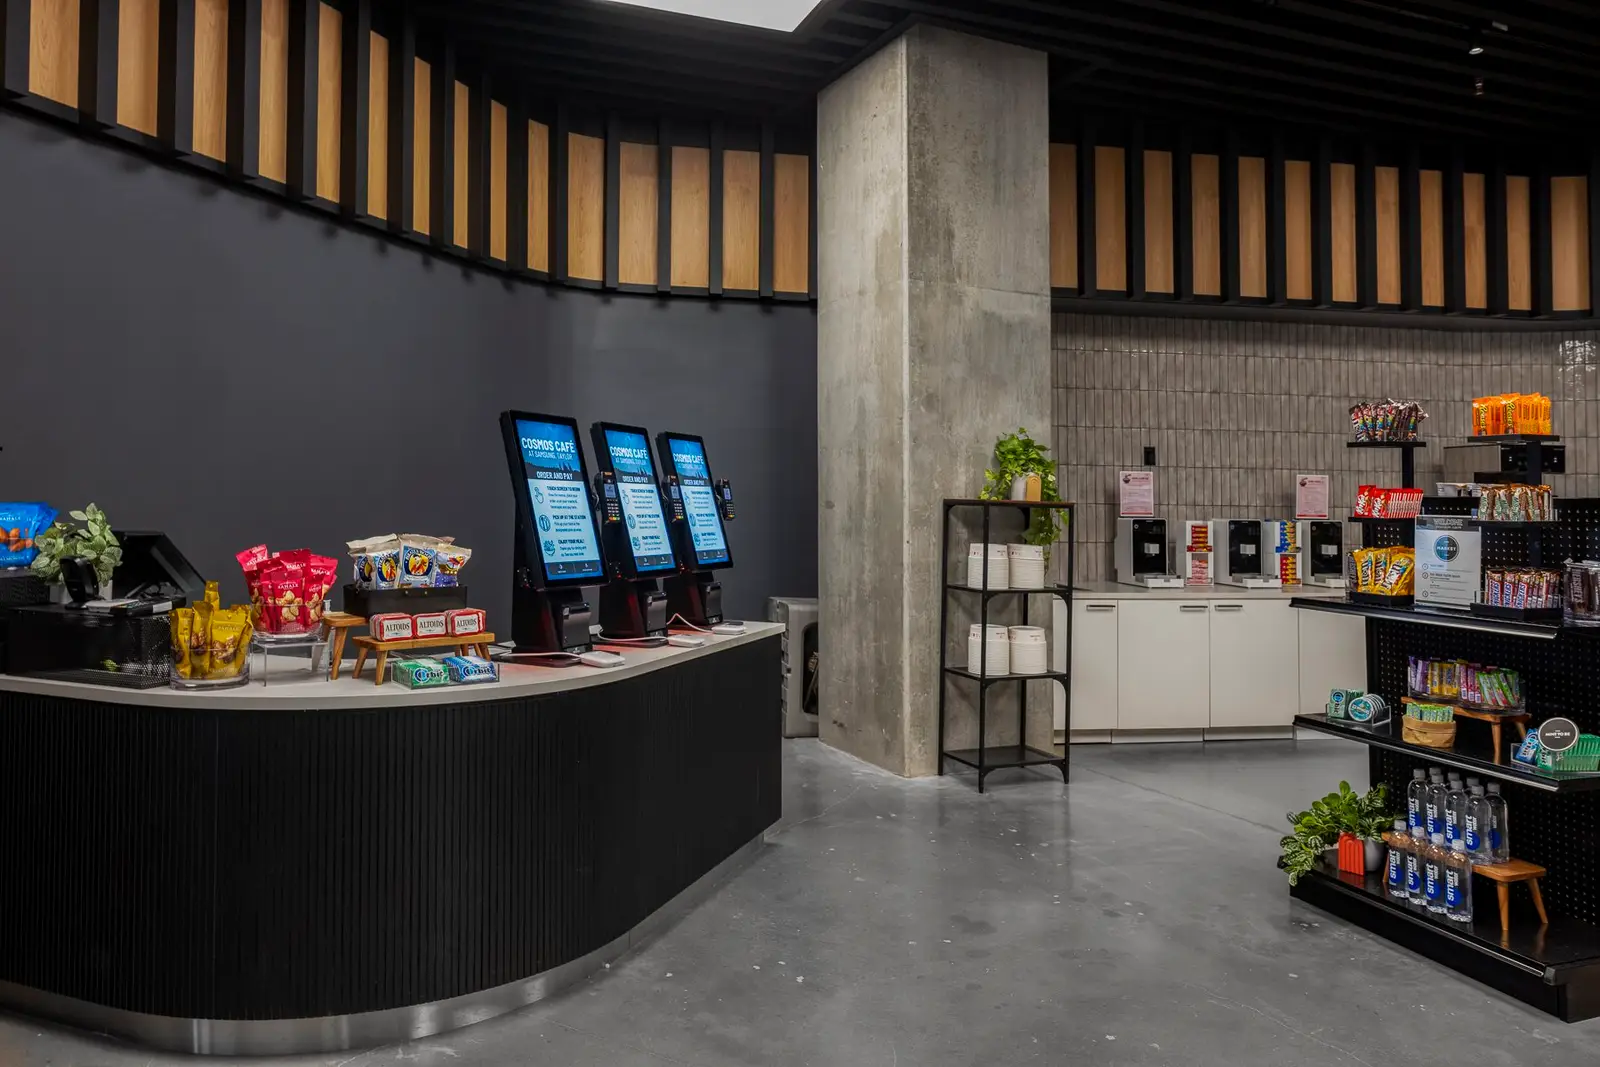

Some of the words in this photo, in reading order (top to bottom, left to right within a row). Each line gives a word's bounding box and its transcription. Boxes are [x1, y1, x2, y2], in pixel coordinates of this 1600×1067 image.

[522, 438, 554, 451] COSMOS
[555, 440, 576, 453] CAFÉ
[610, 446, 633, 458] COSMOS
[633, 448, 648, 459] CAFÉ
[673, 453, 691, 463] COSMOS
[536, 471, 554, 479] ORDER
[386, 623, 410, 632] ALTOIDS
[420, 620, 444, 628] ALTOIDS
[456, 619, 477, 627] ALTOIDS
[415, 668, 444, 682] Orbit
[462, 665, 491, 678] Orbit
[1426, 863, 1434, 894] smart
